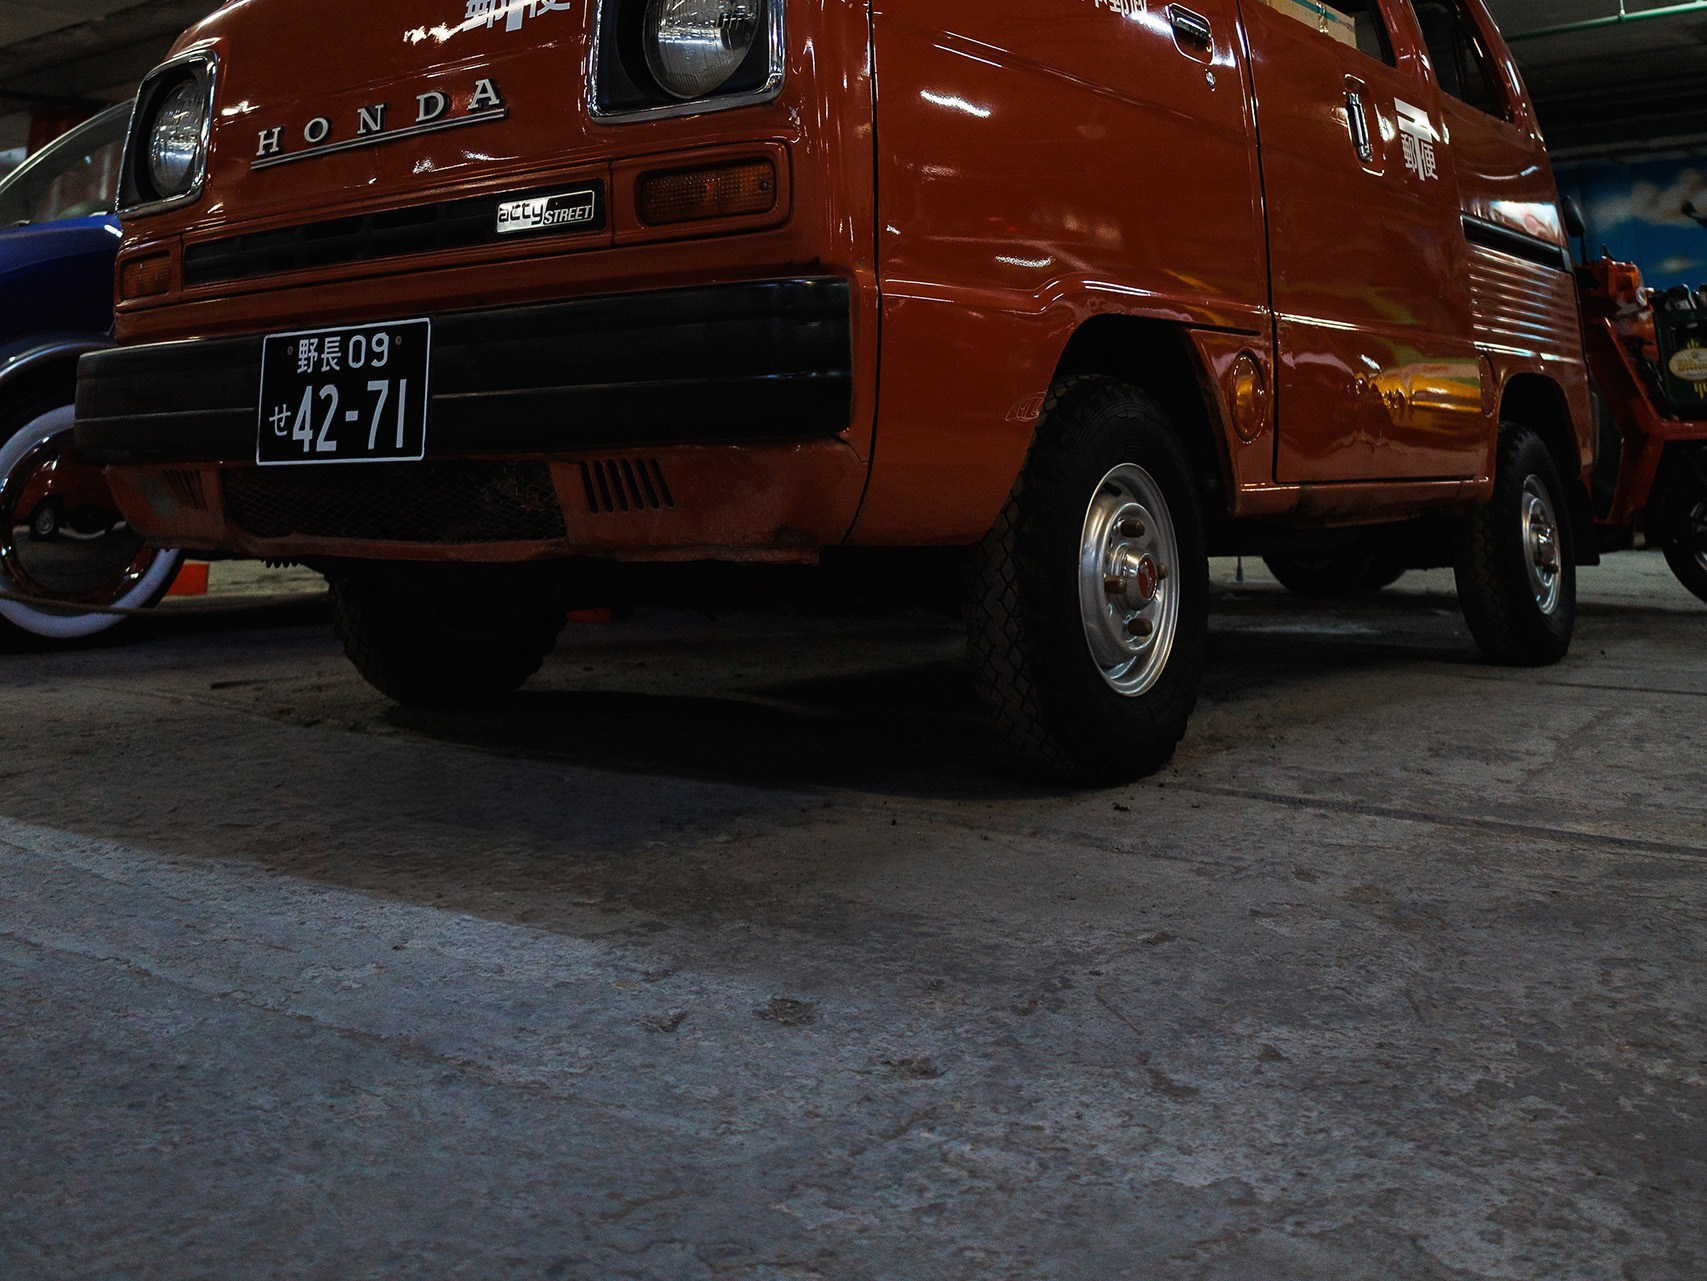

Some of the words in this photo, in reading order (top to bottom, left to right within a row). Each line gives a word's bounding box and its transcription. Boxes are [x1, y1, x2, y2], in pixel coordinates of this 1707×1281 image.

[255, 77, 501, 158] HONDA
[498, 202, 544, 226] acty
[543, 204, 593, 225] STREET
